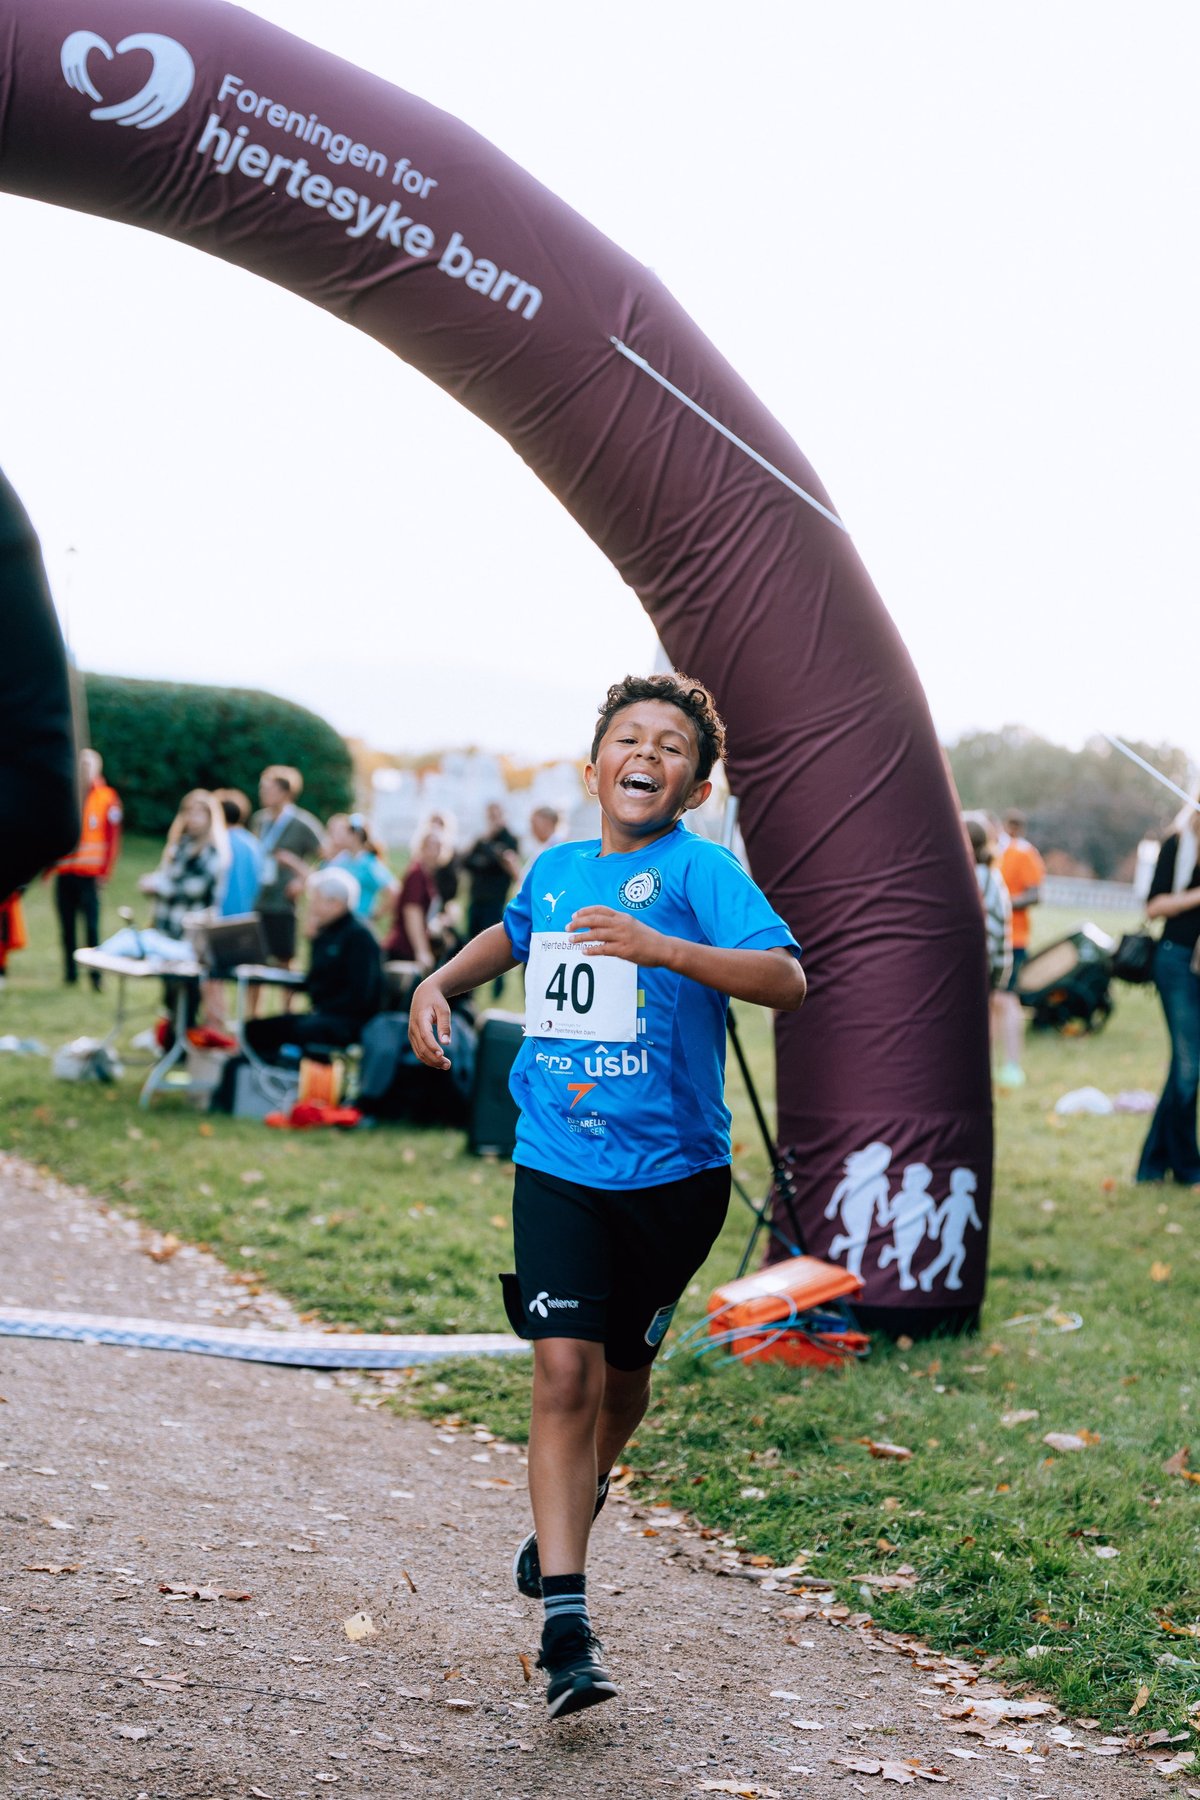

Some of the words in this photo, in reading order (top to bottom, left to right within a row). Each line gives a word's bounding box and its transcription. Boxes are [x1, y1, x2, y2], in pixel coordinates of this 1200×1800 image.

[217, 73, 388, 177] Foreningen
[392, 158, 438, 198] for
[196, 113, 435, 258] hjertesyke
[437, 232, 543, 320] barn
[619, 889, 644, 909] FOOTBALL
[644, 888, 660, 906] CAMP
[545, 962, 595, 1014] 40
[547, 1297, 579, 1309] telenor
